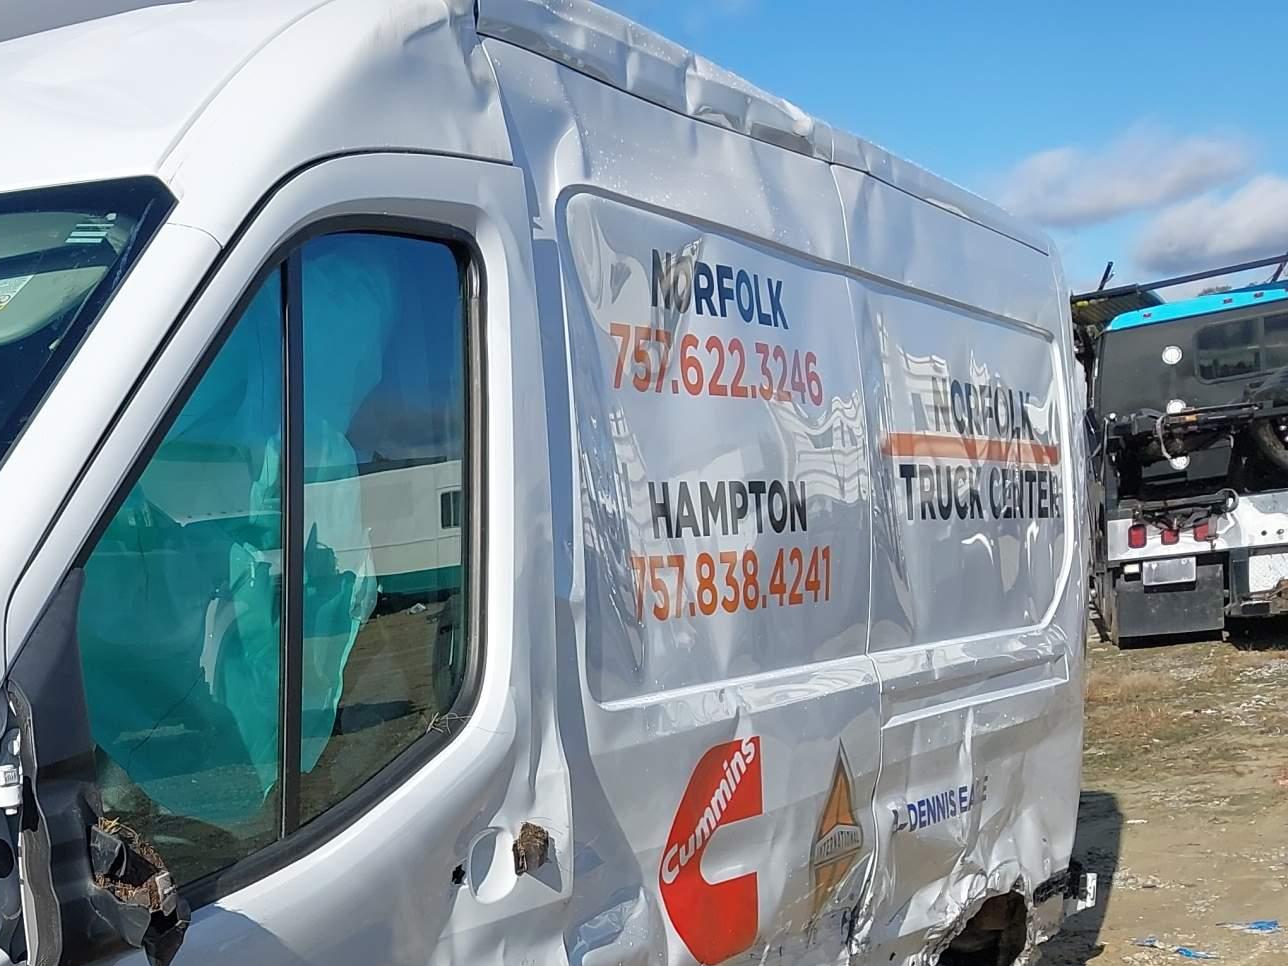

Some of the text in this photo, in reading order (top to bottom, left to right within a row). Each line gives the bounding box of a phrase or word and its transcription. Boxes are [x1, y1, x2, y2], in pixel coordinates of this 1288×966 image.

[651, 248, 790, 330] NORFOLK
[609, 321, 824, 407] 757.622.3246
[931, 375, 1035, 441] NORFOLK
[647, 480, 808, 539] HAMPTON
[899, 463, 1062, 521] TRUCK CENTER
[631, 545, 832, 622] 757.838.4241
[661, 735, 757, 885] Cummins
[906, 789, 958, 833] DENNIS
